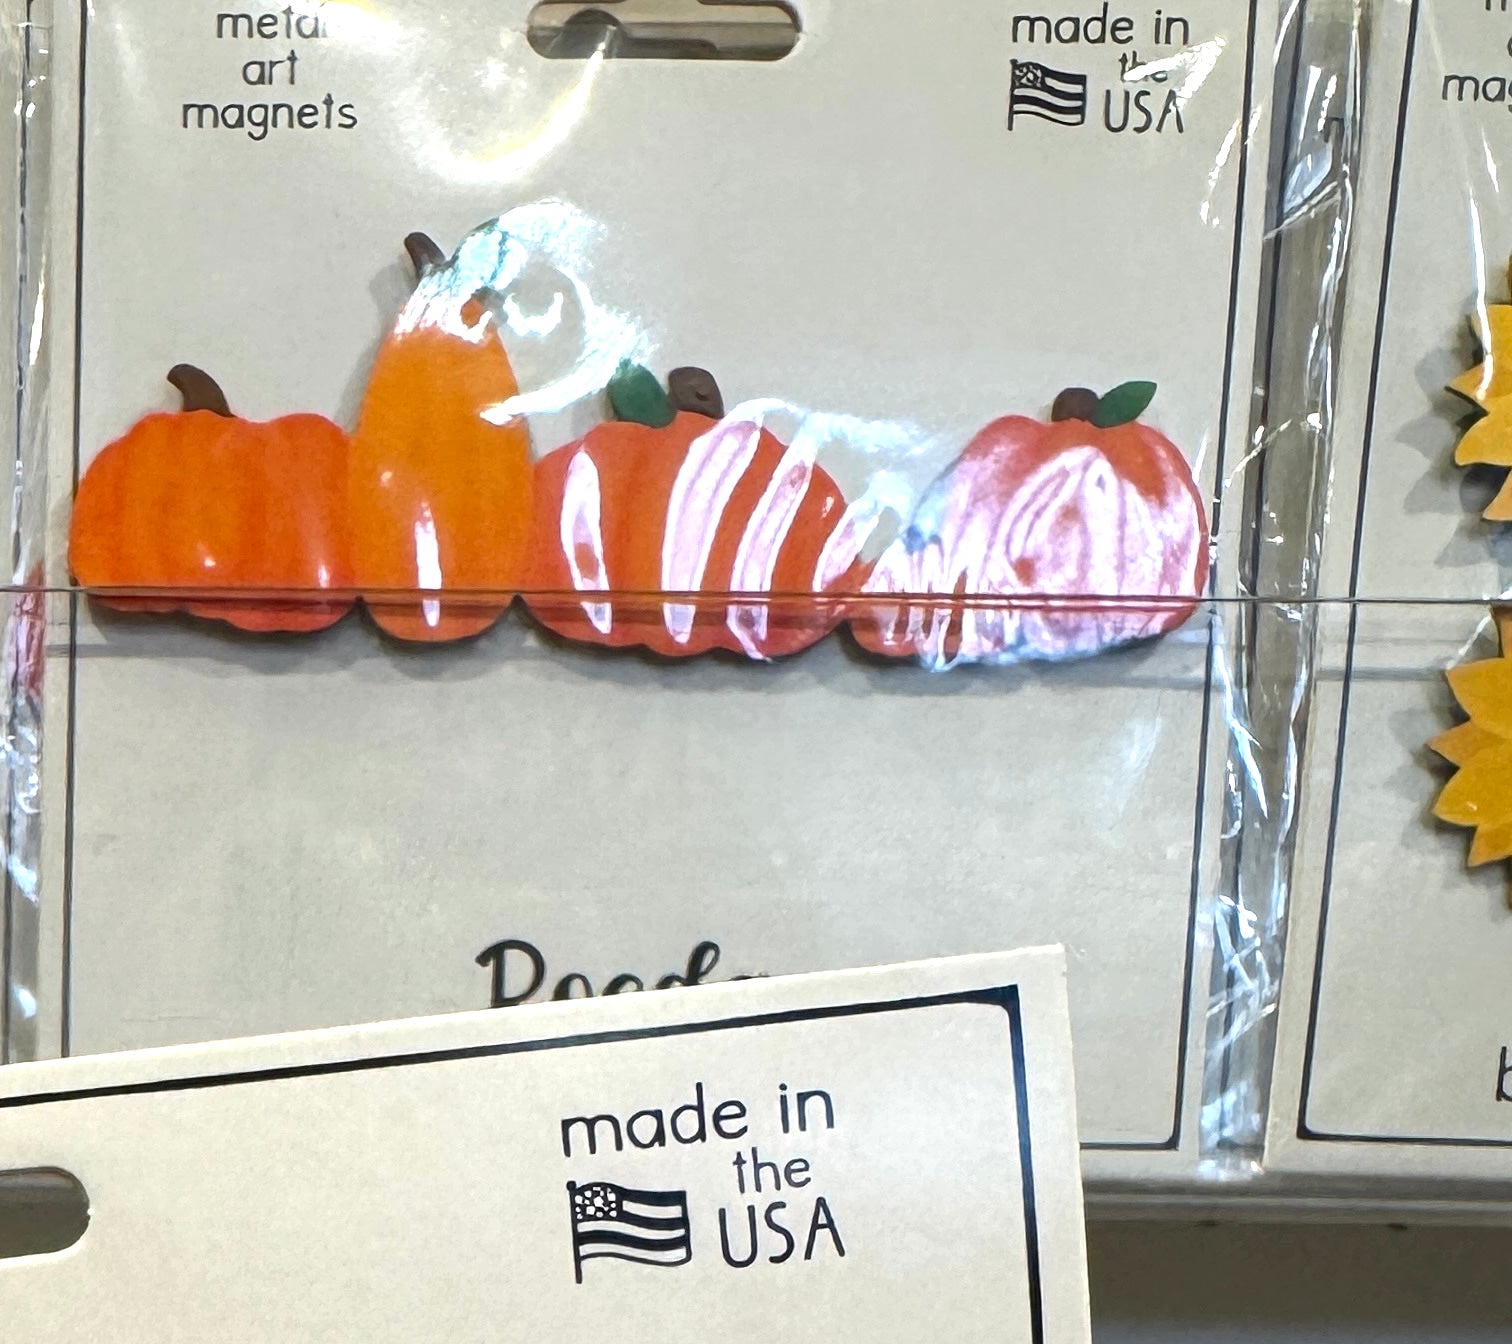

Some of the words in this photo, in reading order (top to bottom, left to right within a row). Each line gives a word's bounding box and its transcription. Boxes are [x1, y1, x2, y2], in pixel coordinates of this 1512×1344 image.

[216, 5, 328, 39] meta
[1012, 1, 1134, 43] made
[1154, 9, 1189, 45] in
[242, 49, 298, 85] art
[182, 93, 358, 141] magnets
[1104, 89, 1185, 133] USA
[561, 1081, 748, 1157] made
[779, 1083, 835, 1134] in
[732, 1146, 812, 1194] the
[718, 1196, 846, 1268] USA
